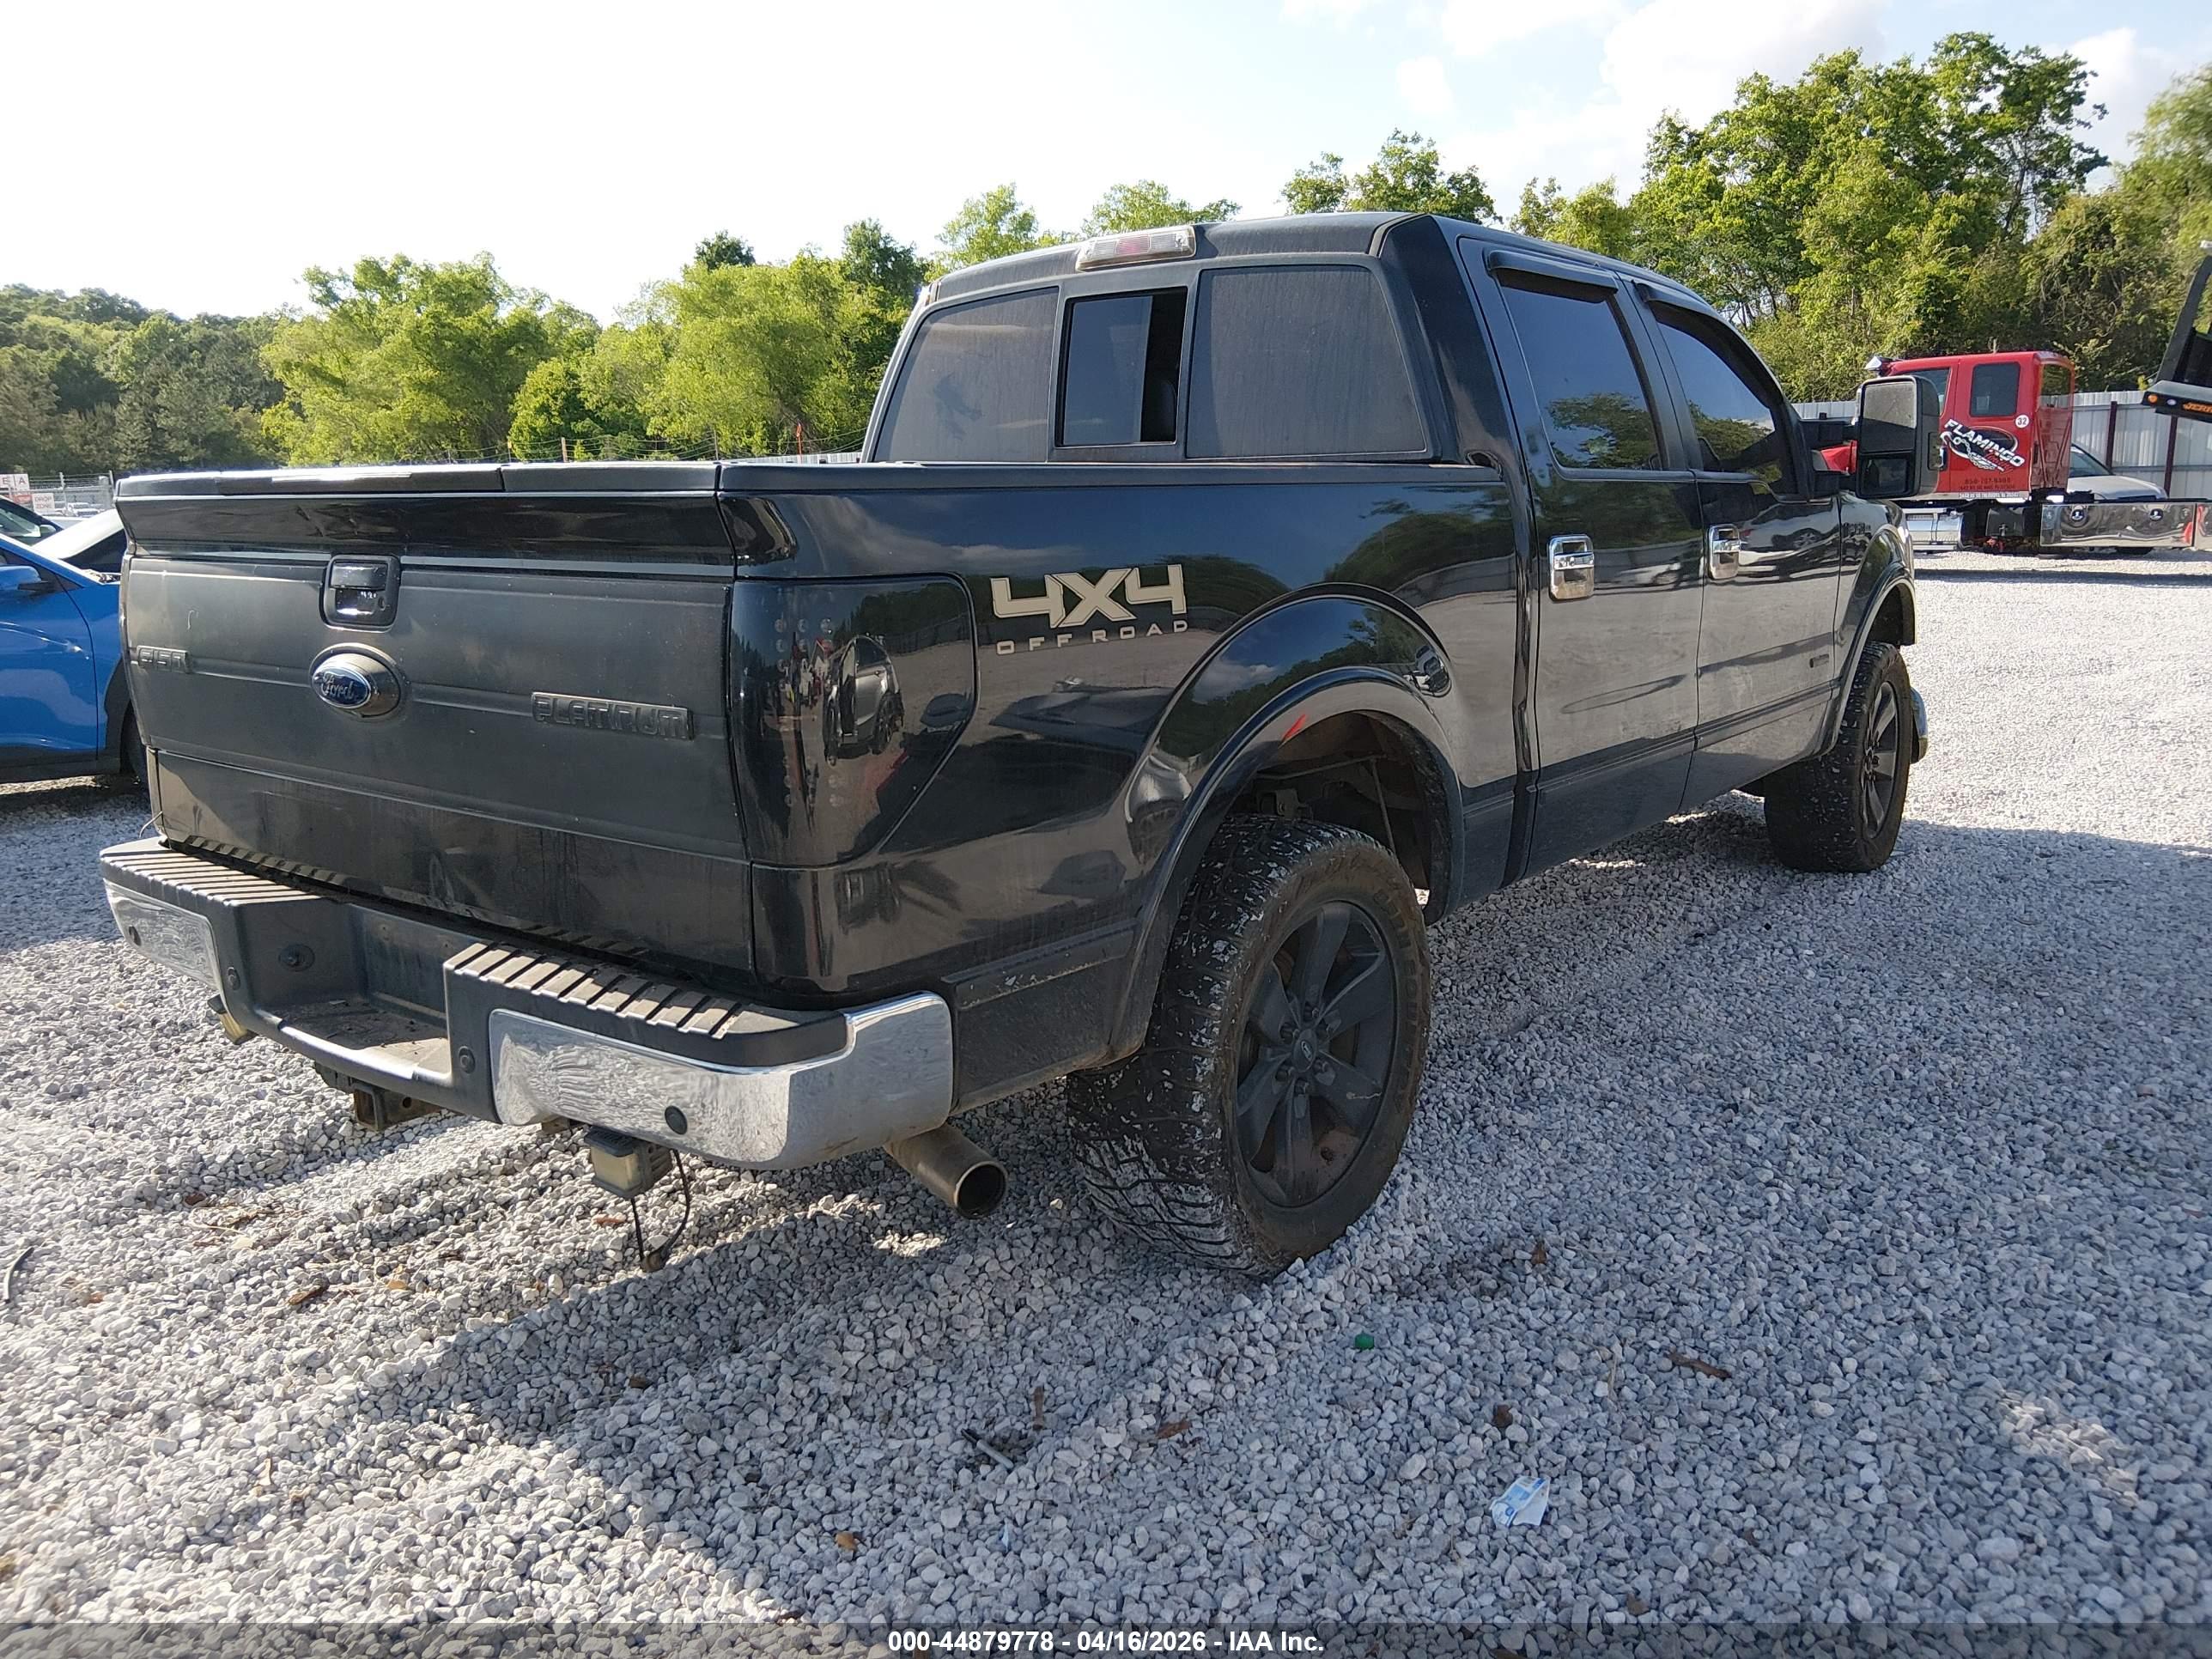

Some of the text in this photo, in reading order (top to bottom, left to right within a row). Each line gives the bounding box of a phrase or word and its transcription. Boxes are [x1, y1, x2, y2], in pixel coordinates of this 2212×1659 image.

[2017, 417, 2027, 426] 32
[1944, 418, 2026, 467] FLAMINGO
[321, 672, 355, 700] Ford
[532, 692, 693, 740] PLATINUM
